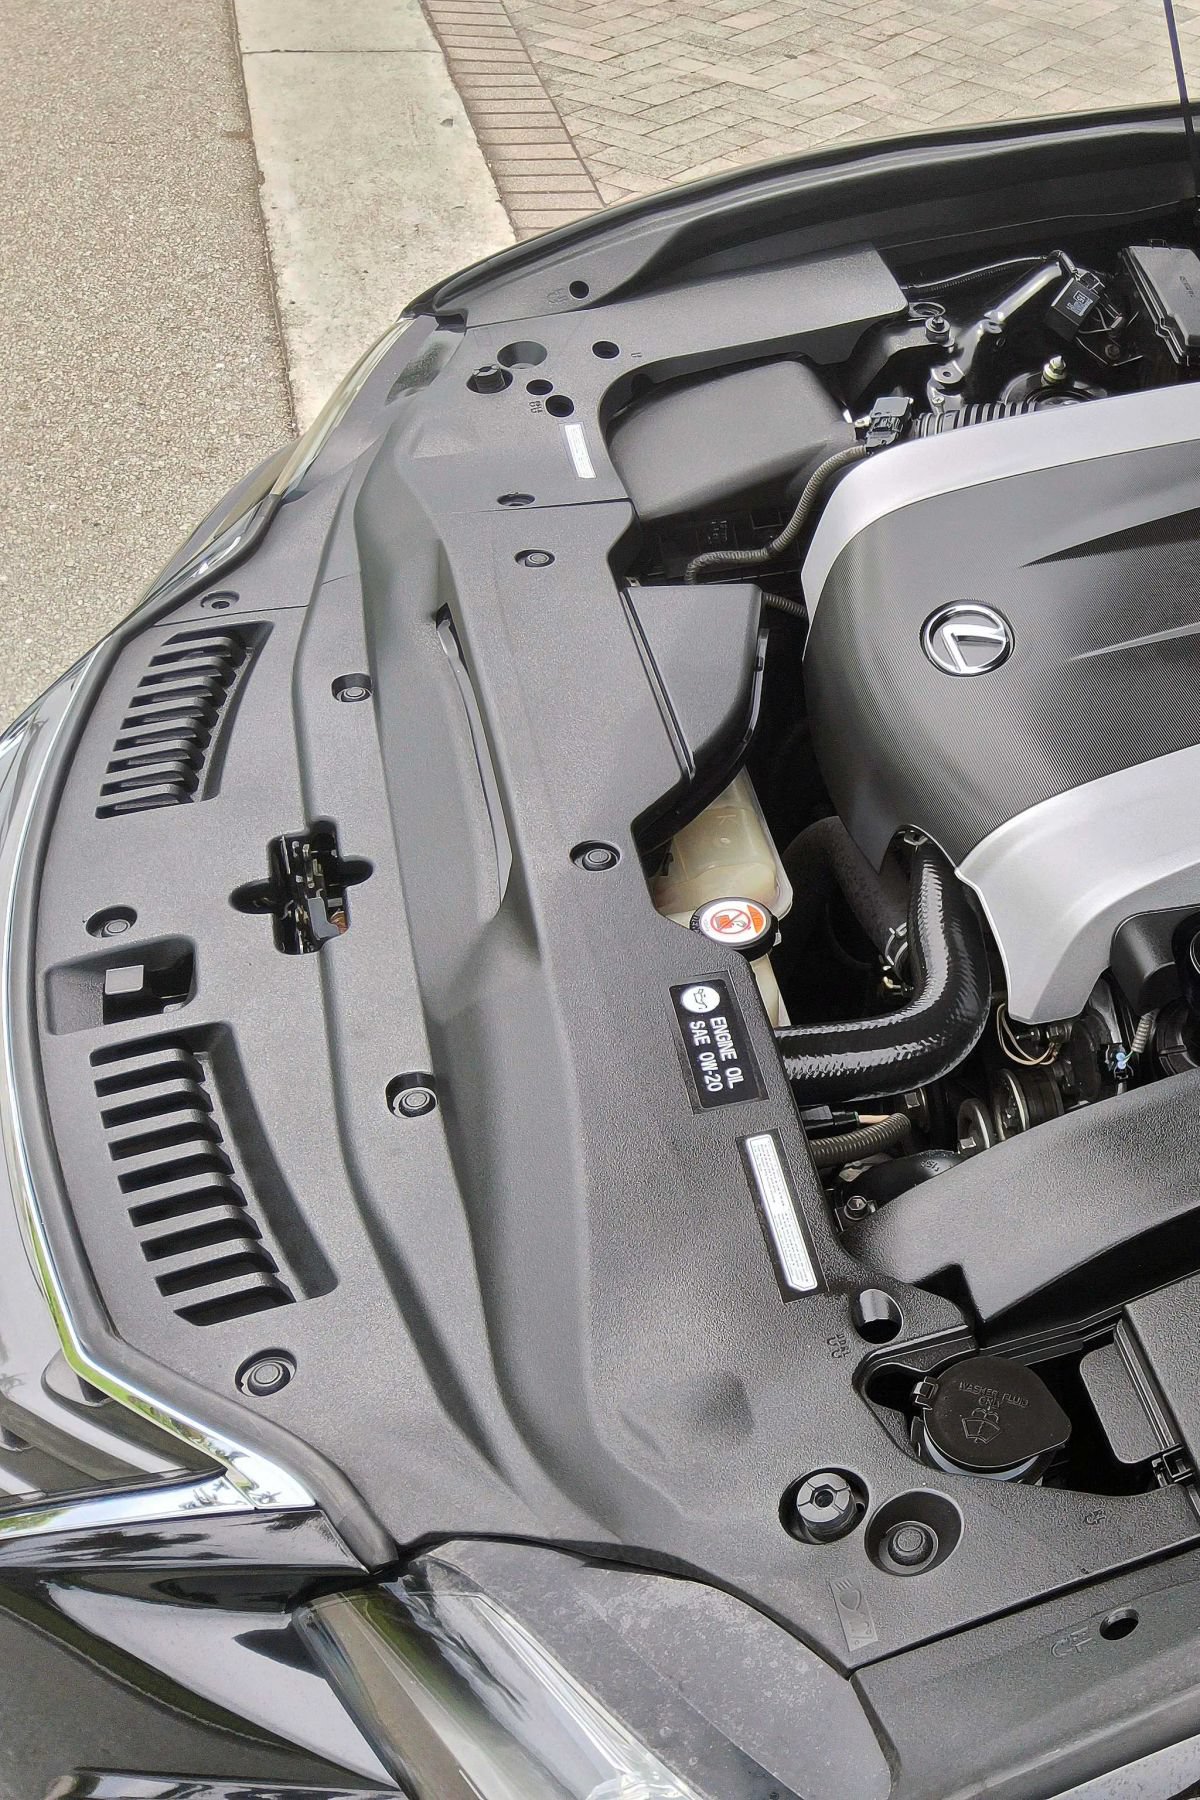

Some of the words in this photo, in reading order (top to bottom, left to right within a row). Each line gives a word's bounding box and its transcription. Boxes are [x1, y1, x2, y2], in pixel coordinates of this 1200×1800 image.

[689, 1020, 711, 1047] SAE
[710, 1016, 737, 1062] ENGINE
[725, 1067, 744, 1090] OIL
[698, 1051, 723, 1093] 0W-20
